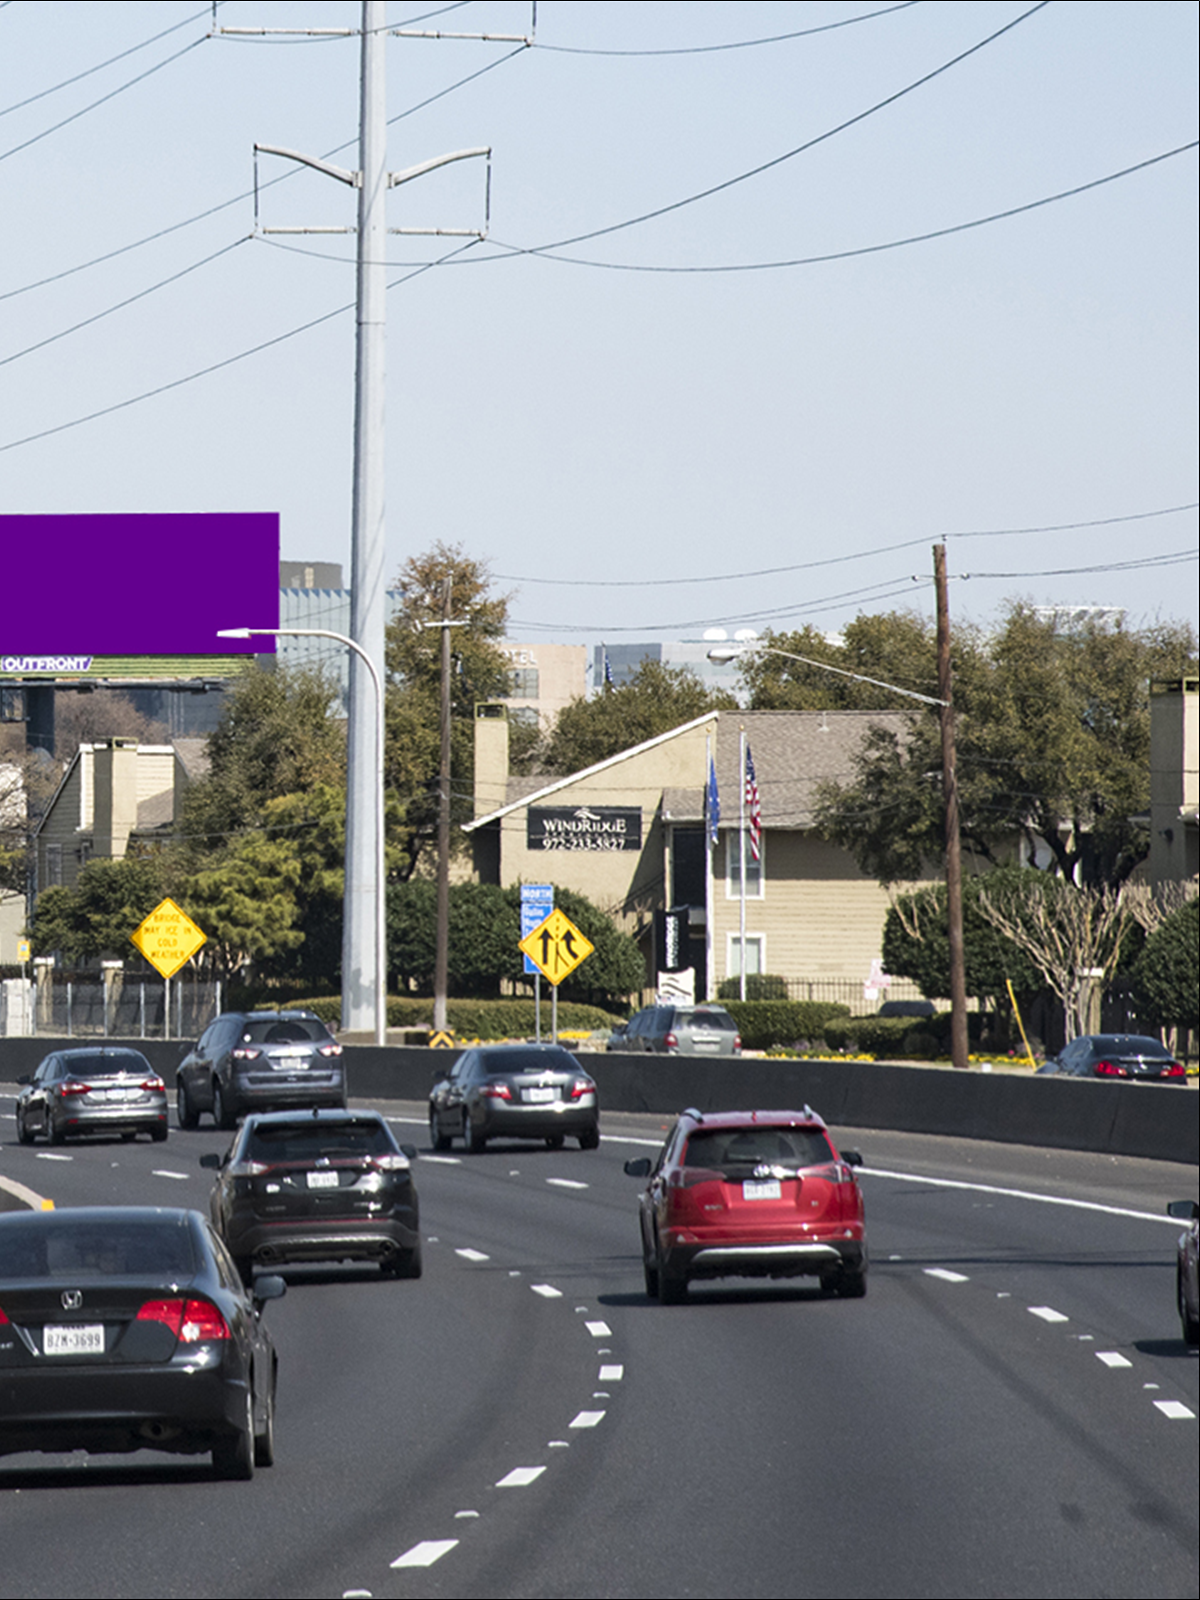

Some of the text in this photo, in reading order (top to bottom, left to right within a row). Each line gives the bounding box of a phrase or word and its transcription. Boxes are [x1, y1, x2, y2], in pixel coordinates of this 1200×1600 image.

[4, 657, 88, 671] OUTFRONT
[542, 818, 627, 833] WINDRIDGE
[154, 914, 181, 923] BRIDGE
[144, 925, 192, 936] MAY ICE IN
[157, 938, 178, 948] COLD
[151, 950, 185, 959] WEATHER
